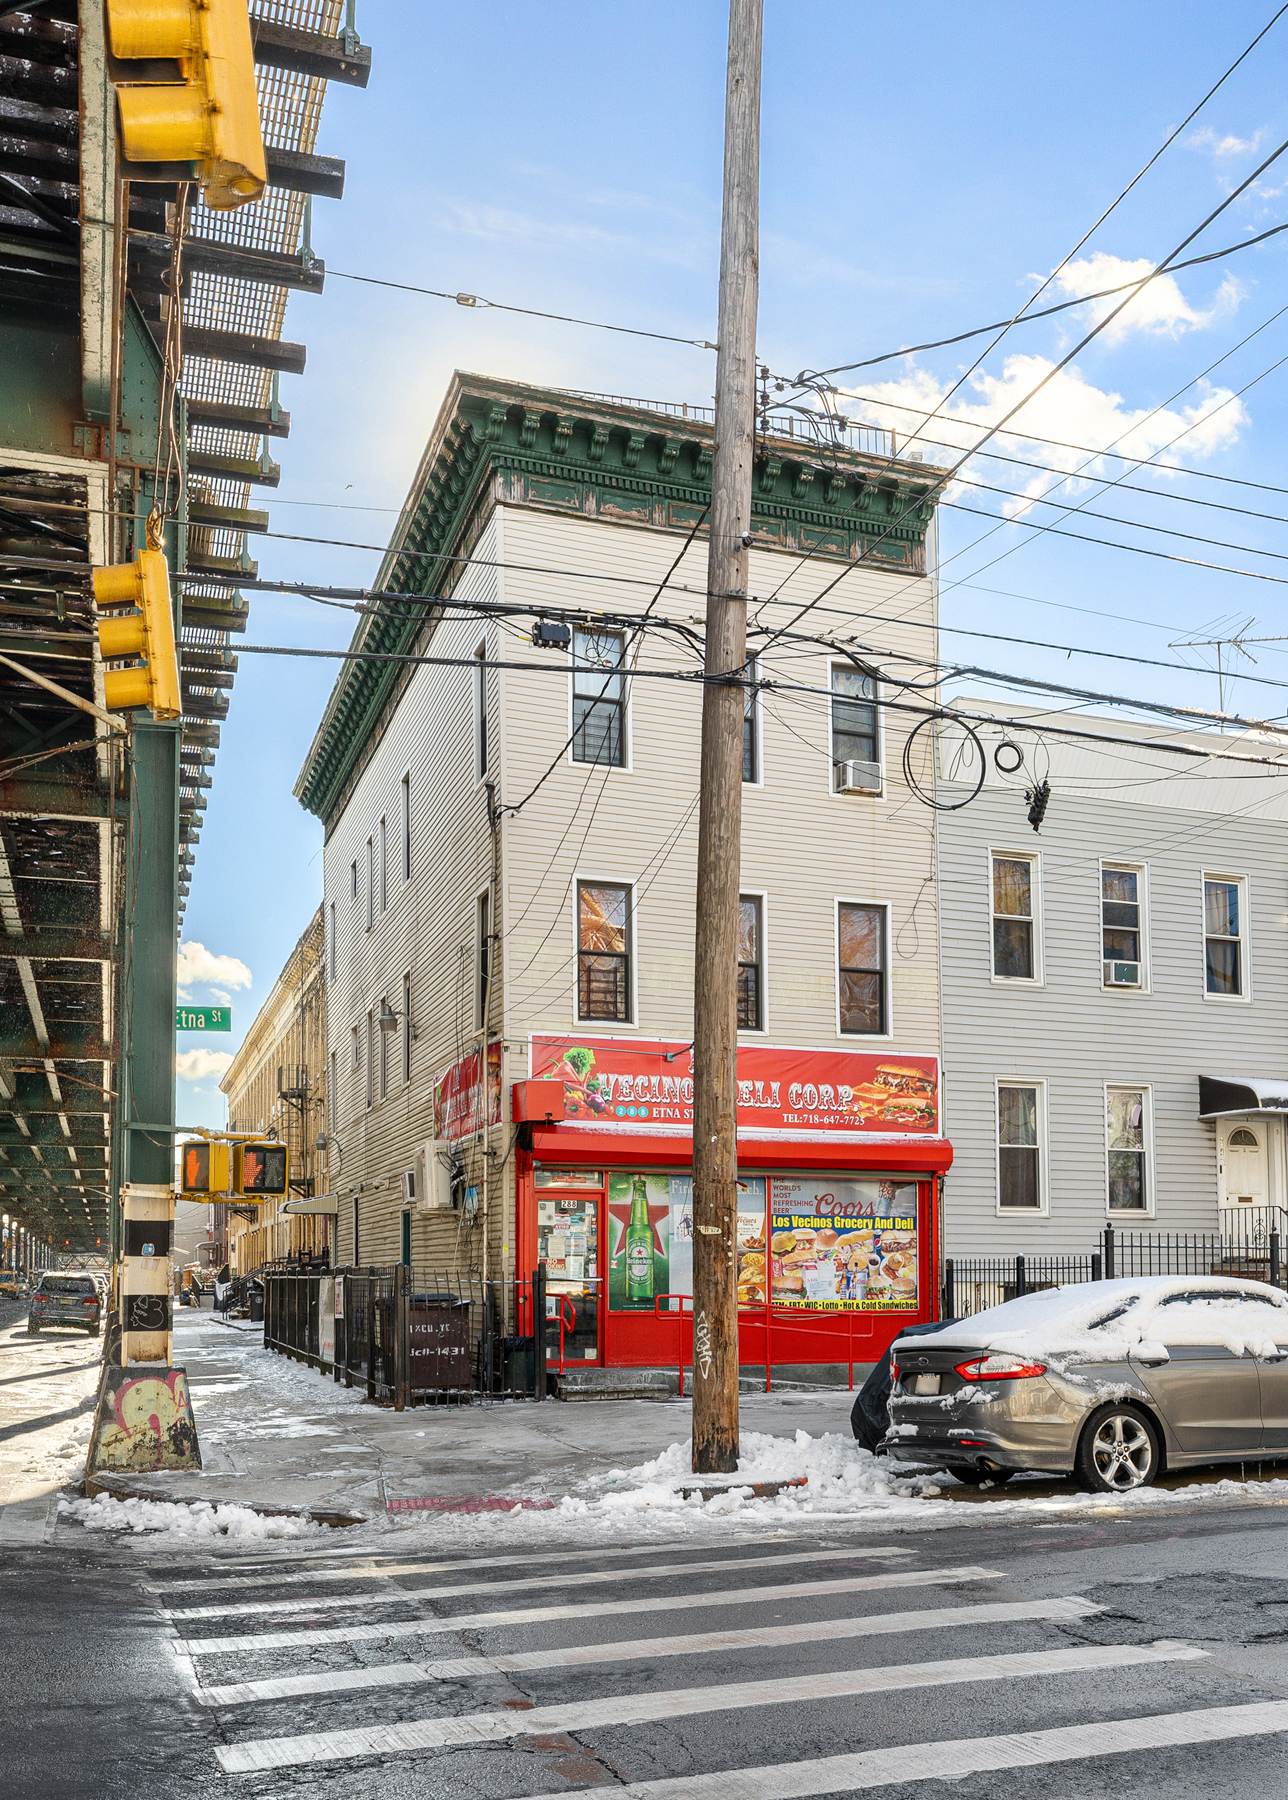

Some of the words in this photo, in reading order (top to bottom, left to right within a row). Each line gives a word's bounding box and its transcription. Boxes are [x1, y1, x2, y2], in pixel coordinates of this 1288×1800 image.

[176, 1010, 205, 1028] Etna
[212, 1010, 222, 1022] St
[597, 1072, 694, 1104] VECINO
[736, 1080, 781, 1109] ELI
[788, 1082, 859, 1112] CORP.
[617, 1105, 648, 1117] 288
[652, 1107, 681, 1119] ETNA
[782, 1113, 865, 1126] TEL:718-647-7725
[562, 1200, 577, 1208] 288
[814, 1193, 876, 1216] Coors
[773, 1215, 790, 1227] Los
[791, 1216, 832, 1228] Vecinos
[834, 1216, 873, 1230] Grocery
[875, 1217, 893, 1229] And
[895, 1218, 914, 1230] Deli
